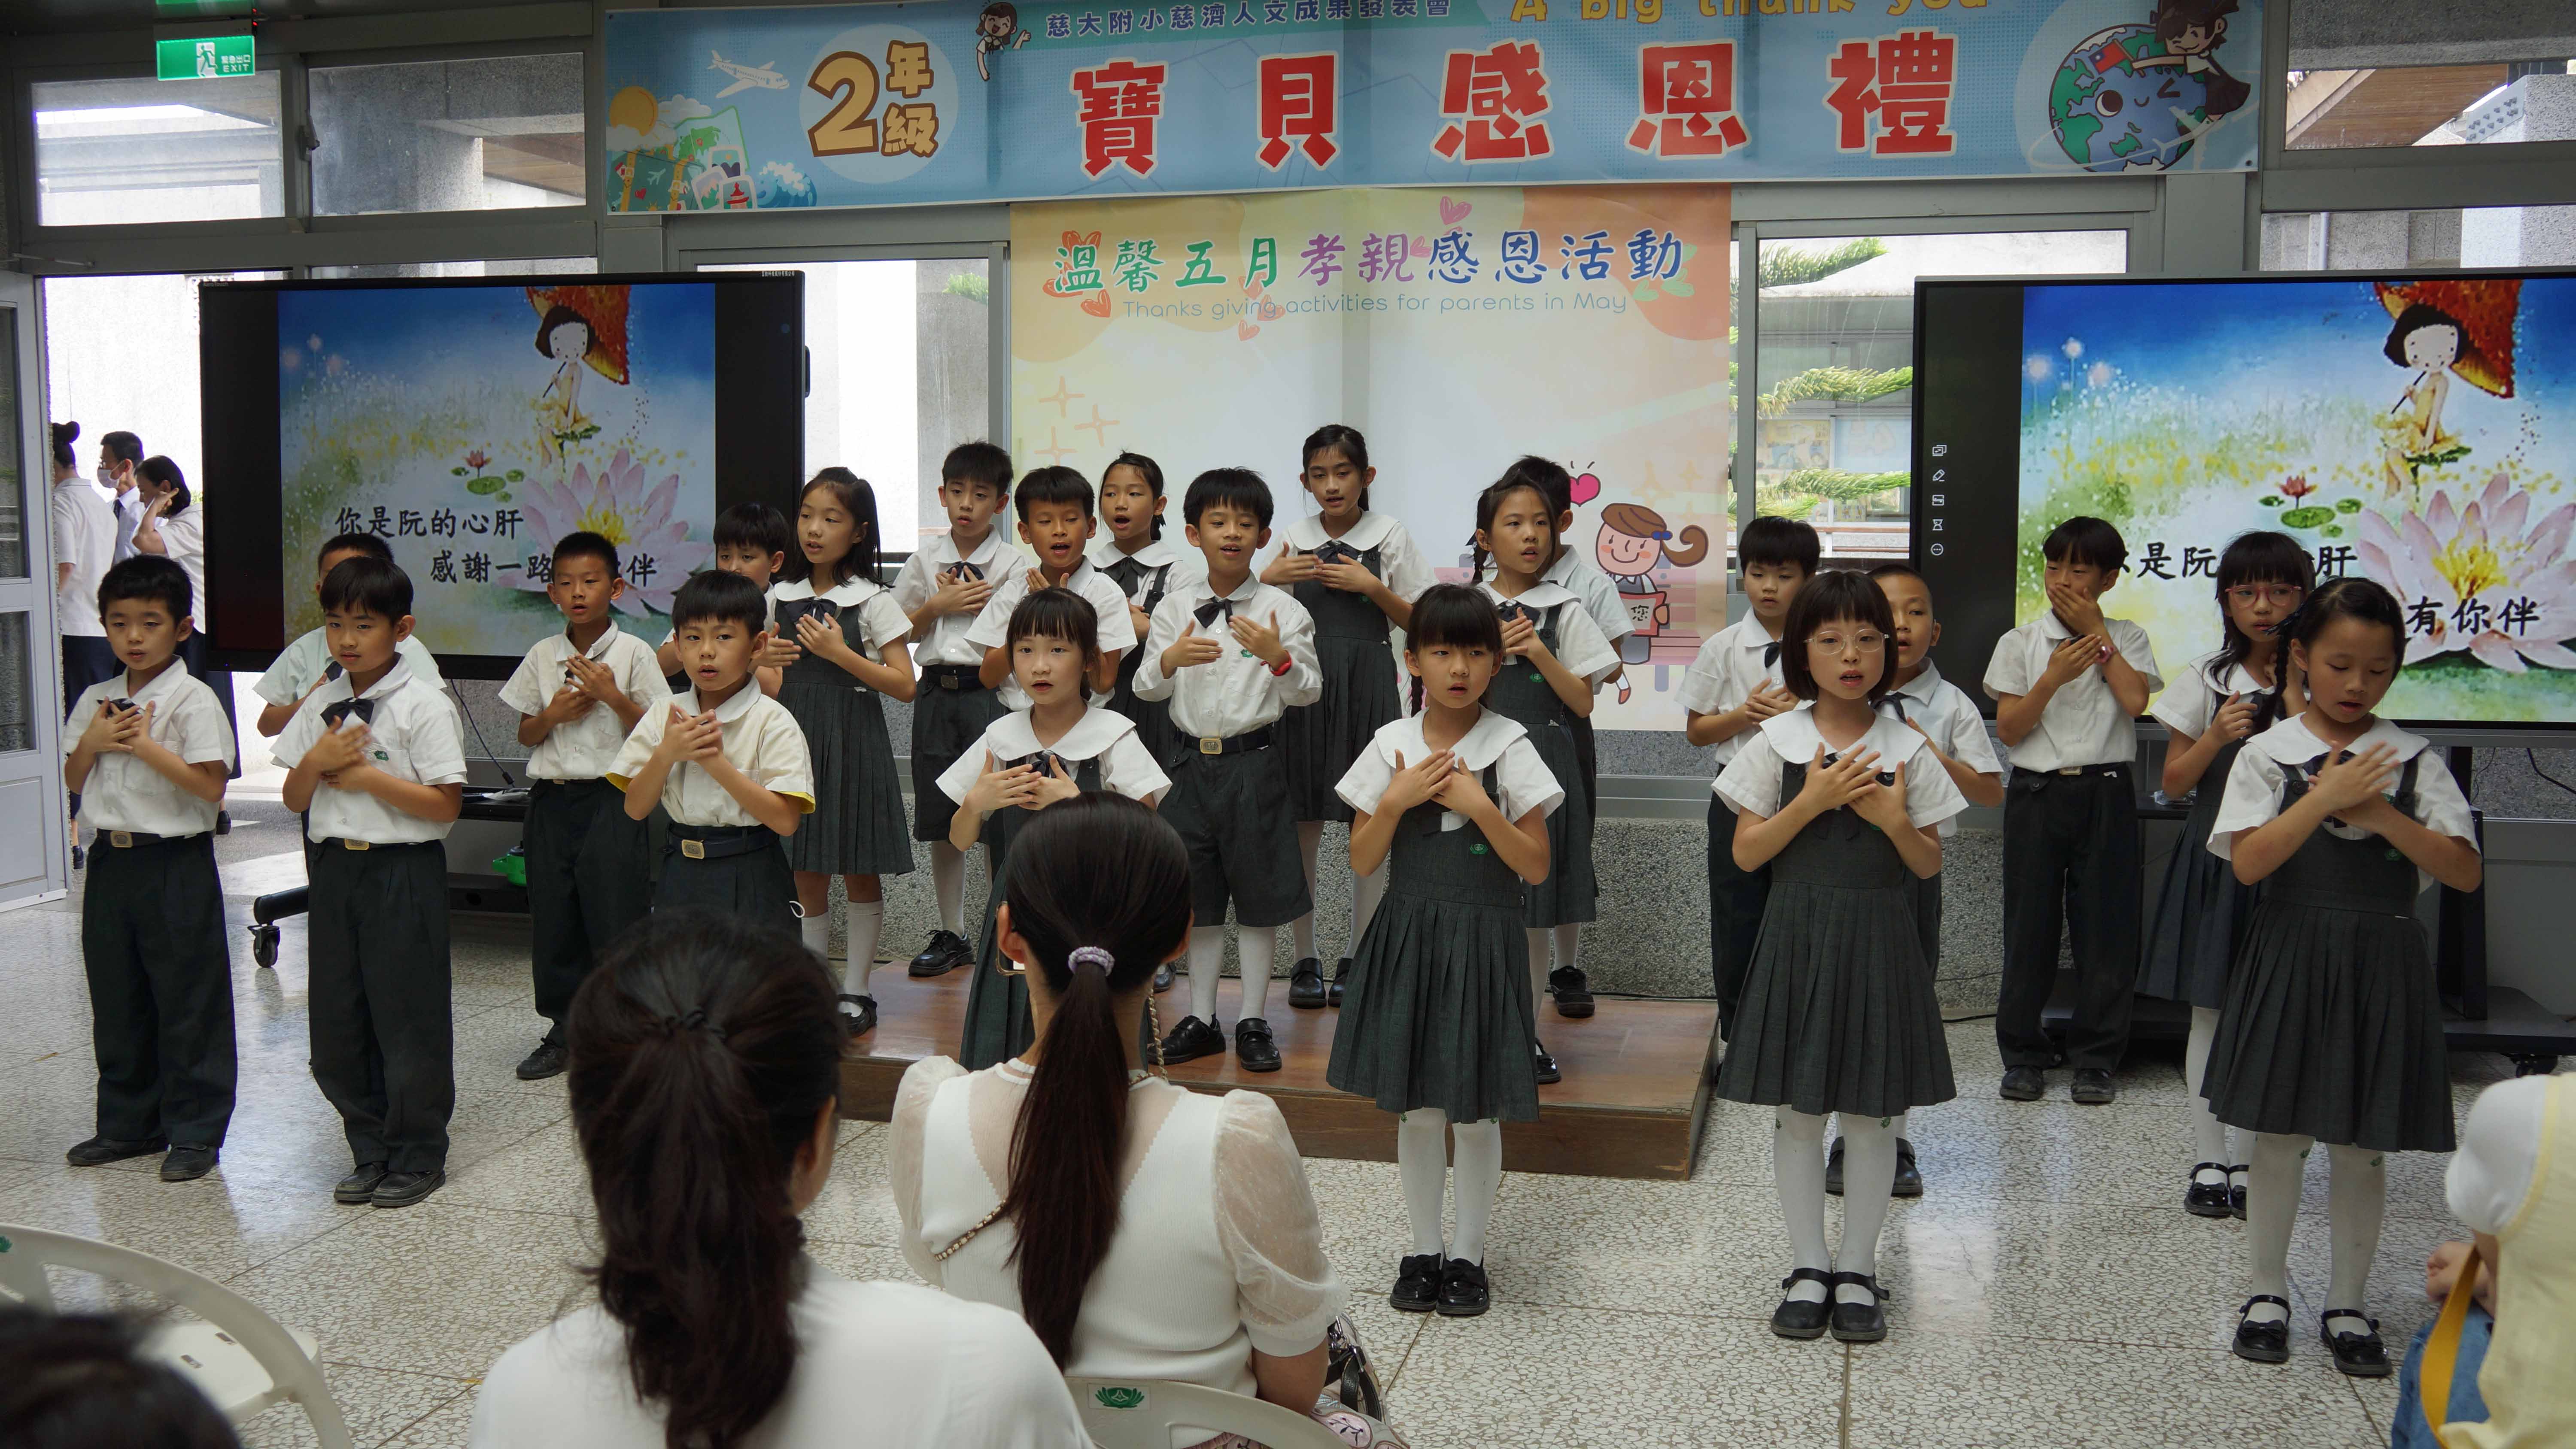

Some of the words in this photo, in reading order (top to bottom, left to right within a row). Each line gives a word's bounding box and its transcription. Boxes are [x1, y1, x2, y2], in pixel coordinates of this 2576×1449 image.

[1046, 0, 1449, 38] 慈大附小慈濟人文成果發表會
[1510, 0, 1547, 22] A
[1581, 0, 1663, 24] big
[221, 55, 251, 64] 緊急出口
[223, 64, 249, 73] EXIT
[1071, 31, 1955, 178] 寶貝感恩禮
[1054, 228, 1683, 293] 溫馨五月孝親感恩活動
[1123, 301, 1202, 318] Thanks
[1212, 298, 1277, 320] giving
[1286, 294, 1388, 313] activities
[1397, 294, 1427, 311] for
[1440, 294, 1534, 314] parents
[1546, 293, 1564, 309] in
[1574, 293, 1627, 314] May
[334, 506, 524, 540] 你是阮的心肝
[430, 549, 657, 587] 感謝一路伴
[1631, 604, 1649, 621] 您
